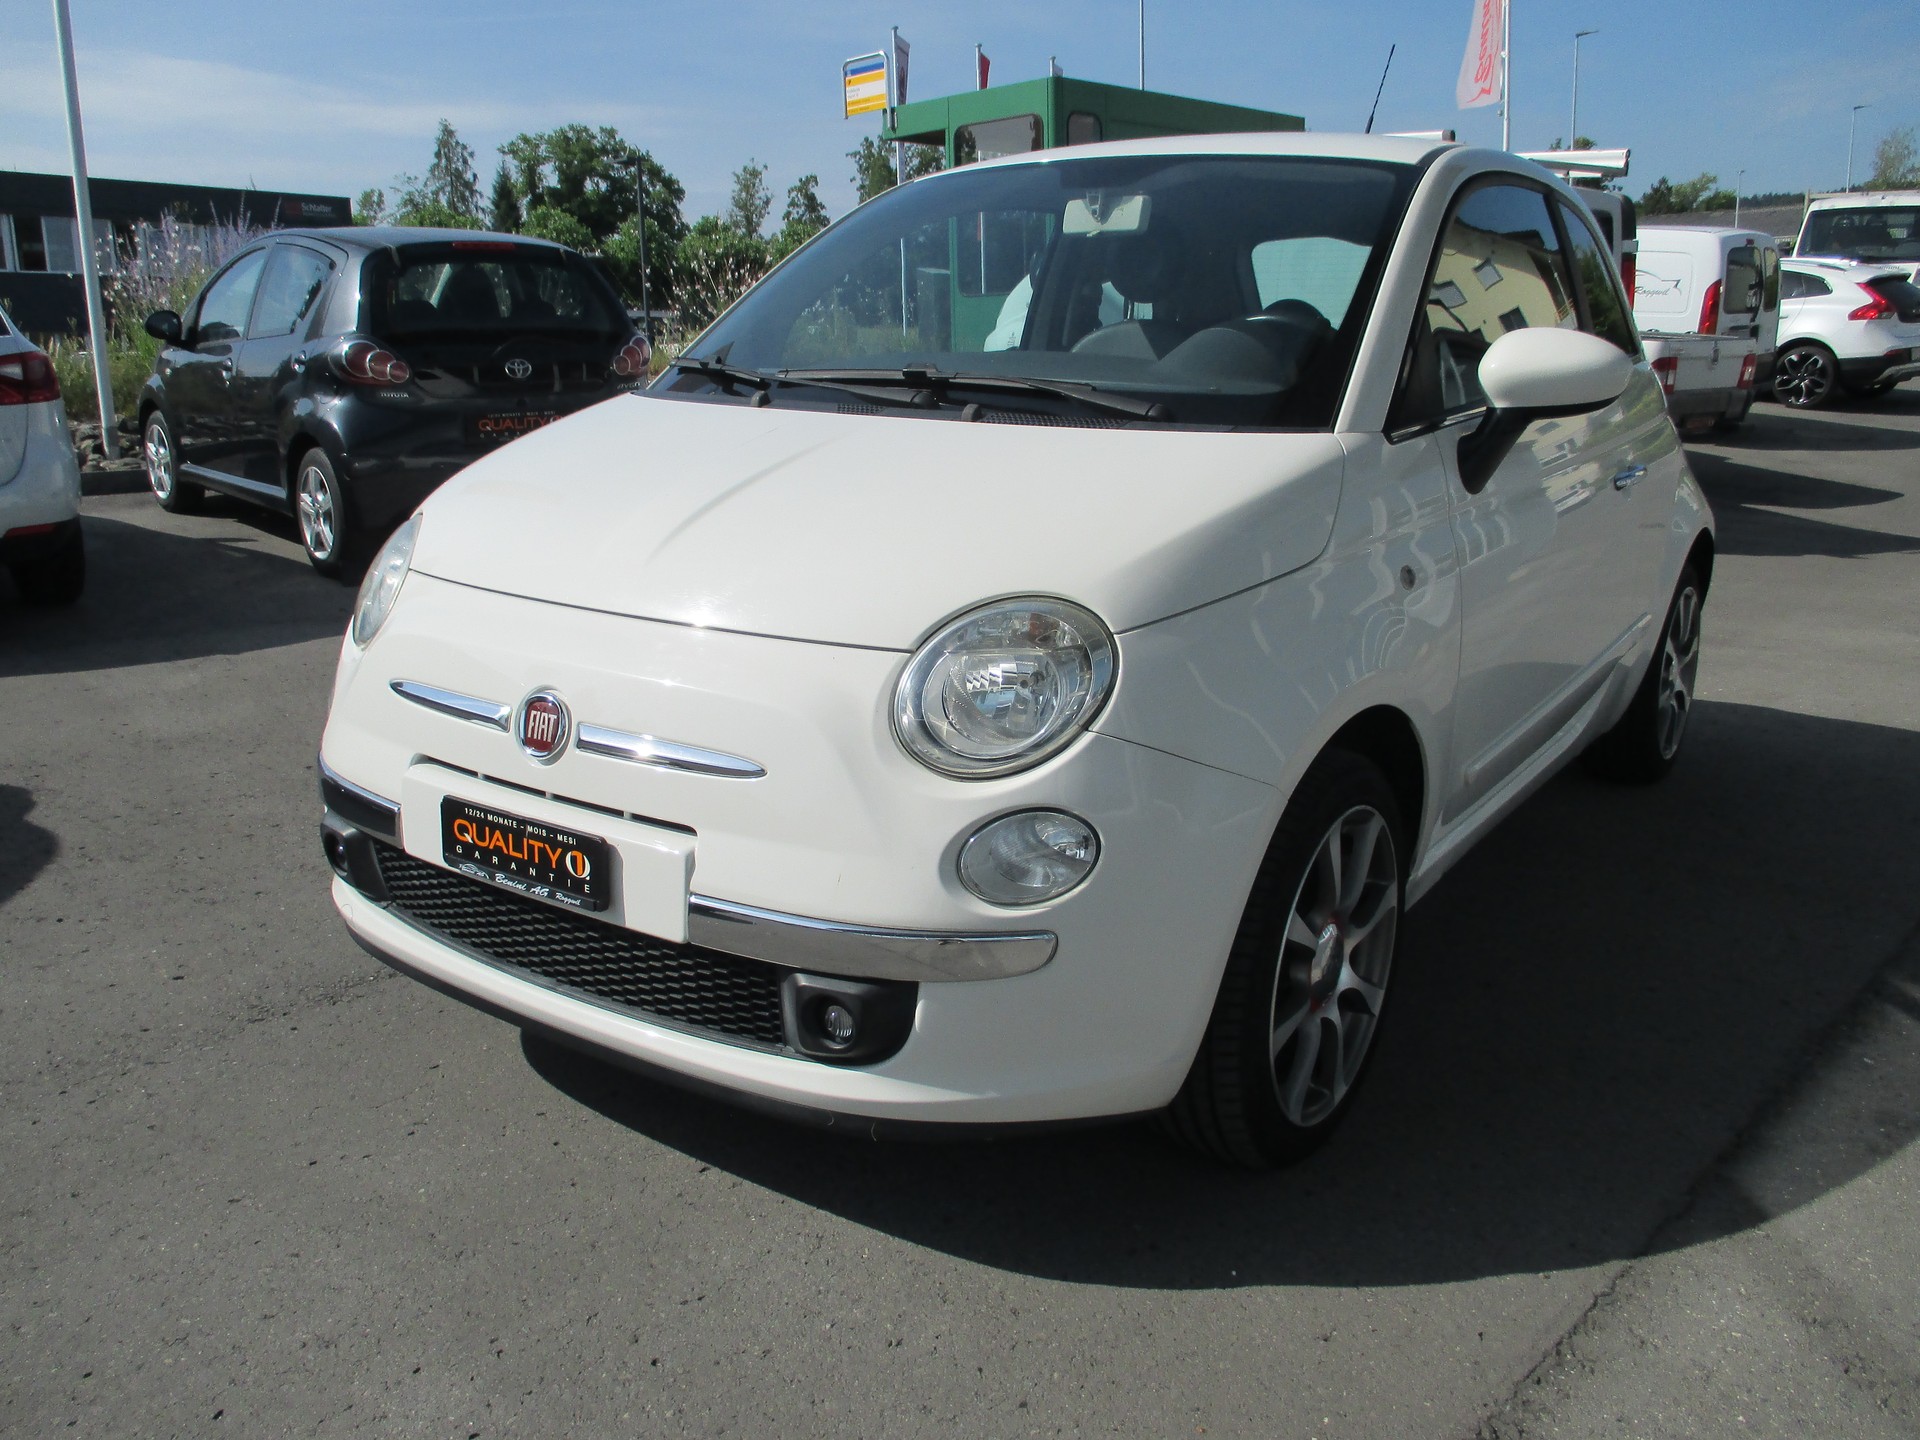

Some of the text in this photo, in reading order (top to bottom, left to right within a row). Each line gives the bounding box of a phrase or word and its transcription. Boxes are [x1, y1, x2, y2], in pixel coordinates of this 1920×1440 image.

[301, 203, 331, 212] Schlatter
[478, 416, 547, 431] QUALITY
[528, 710, 557, 742] FIAT
[453, 818, 563, 869] QUALITY
[464, 807, 485, 819] 12/24
[487, 814, 518, 829] MONATE
[527, 824, 547, 837] MOIS
[557, 833, 577, 846] MESI
[456, 844, 591, 893] GARANTIE
[495, 873, 582, 907] Benini AG Roggwil
